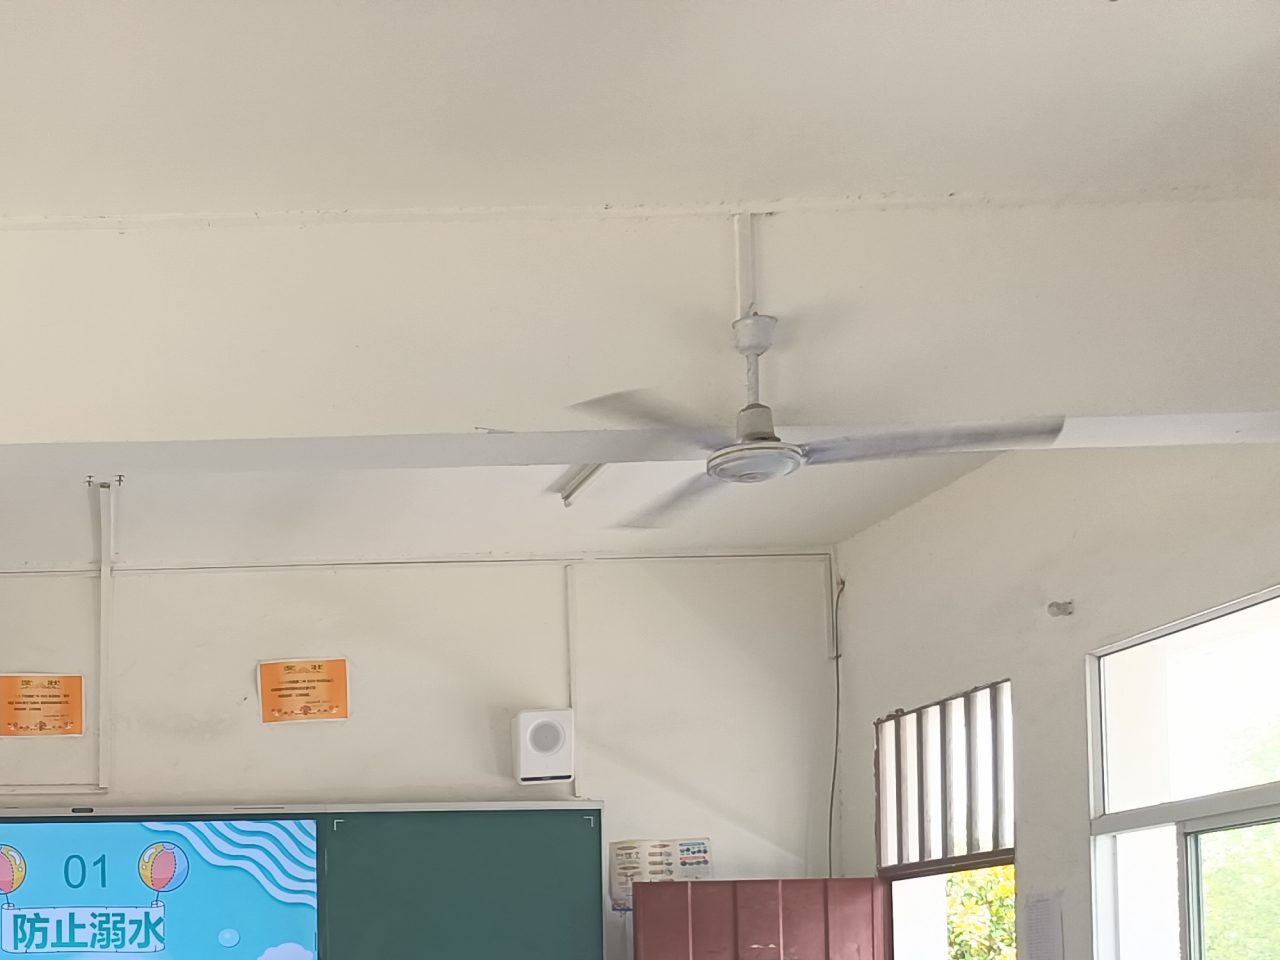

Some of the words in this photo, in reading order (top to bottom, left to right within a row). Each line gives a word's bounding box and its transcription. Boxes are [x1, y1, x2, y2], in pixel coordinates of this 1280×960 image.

[64, 854, 107, 888] 01
[12, 911, 166, 950] 防止溺水
